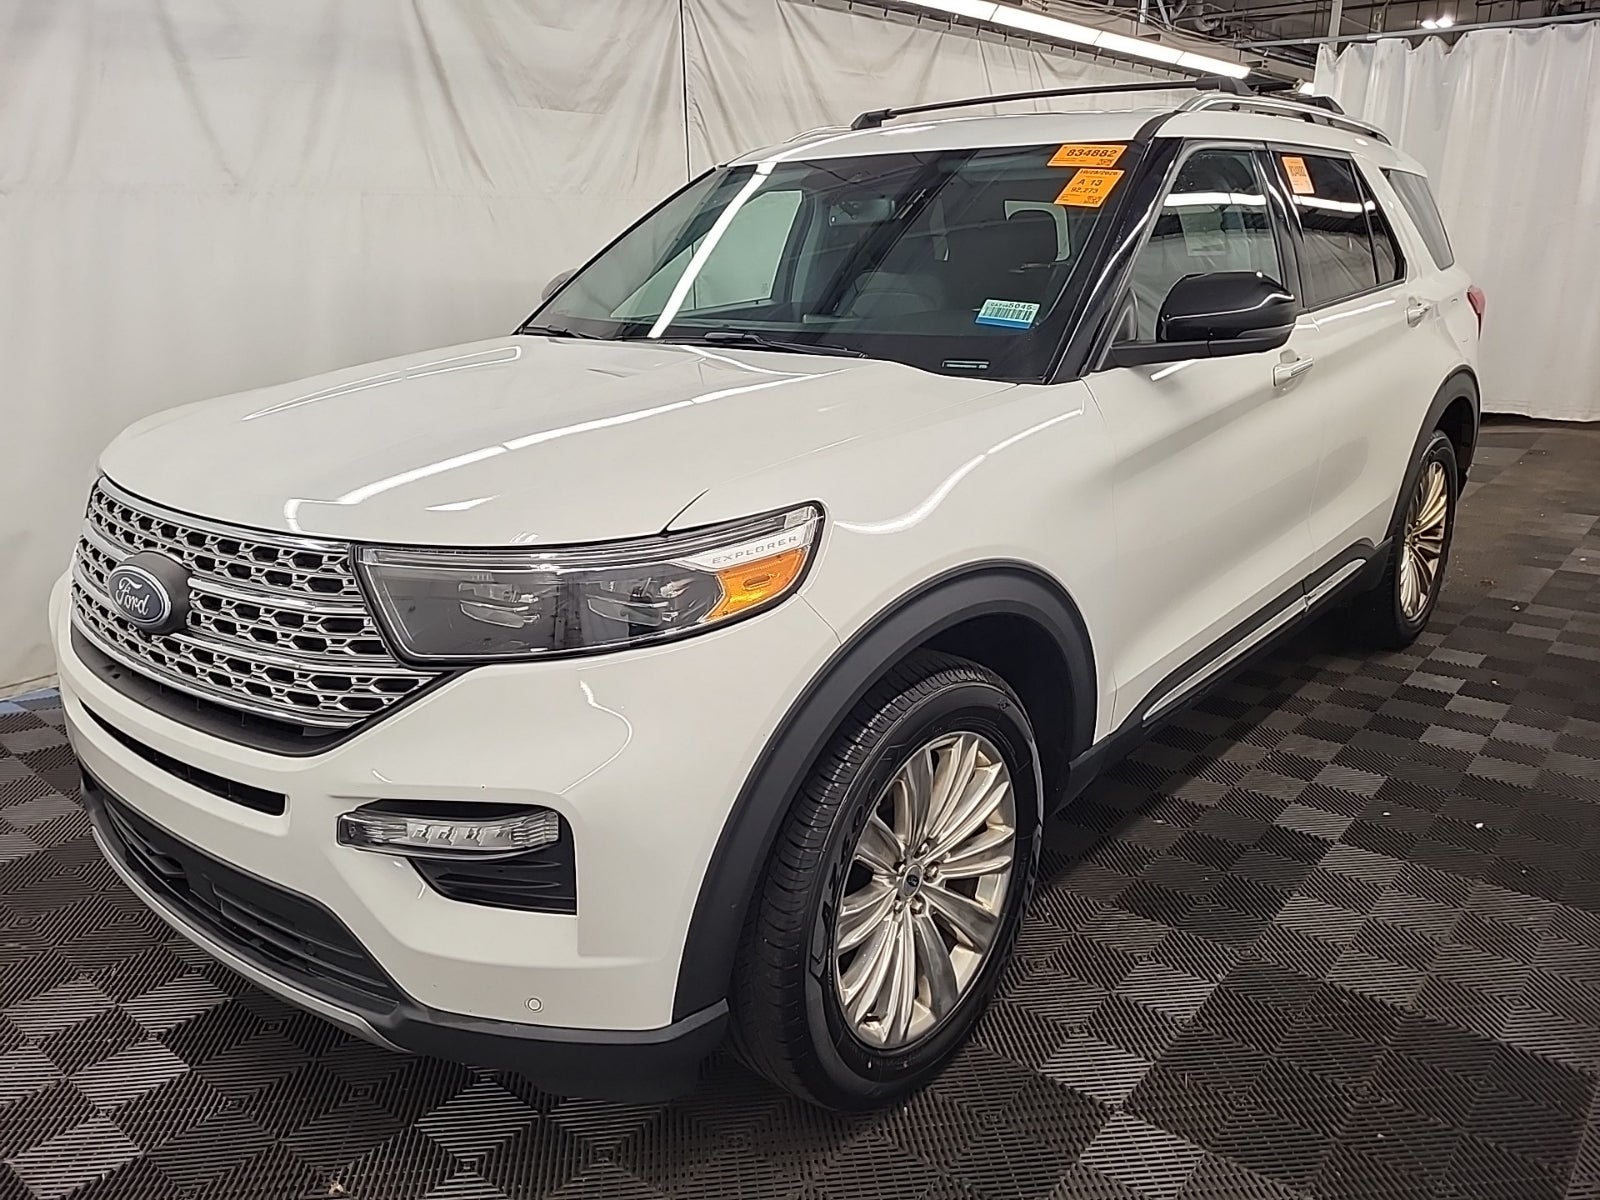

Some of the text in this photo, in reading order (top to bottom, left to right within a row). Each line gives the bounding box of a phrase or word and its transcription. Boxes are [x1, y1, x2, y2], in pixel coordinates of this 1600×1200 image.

[1066, 148, 1118, 158] 834882
[1090, 179, 1103, 187] 13
[712, 536, 797, 564] EXPLORER
[115, 577, 151, 616] Ford
